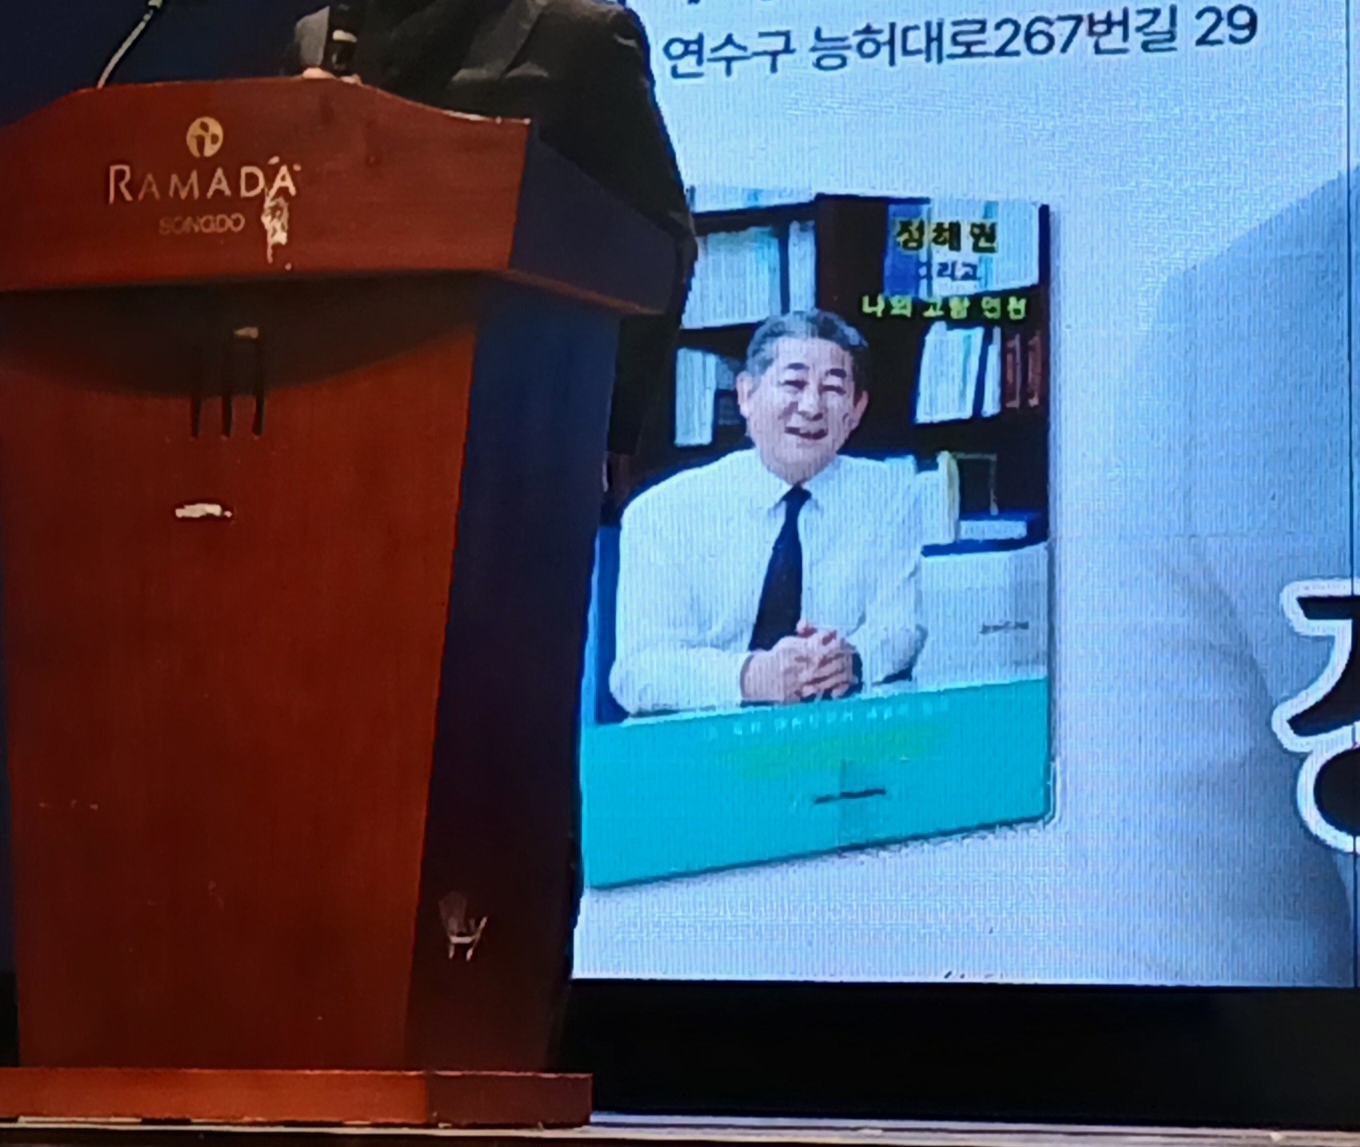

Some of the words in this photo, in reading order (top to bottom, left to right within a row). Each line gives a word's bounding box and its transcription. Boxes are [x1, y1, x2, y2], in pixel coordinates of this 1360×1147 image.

[662, 31, 797, 80] 연수구
[808, 4, 1180, 72] 능허대로267번길
[1193, 4, 1259, 47] 29
[108, 163, 297, 205] RAMADA
